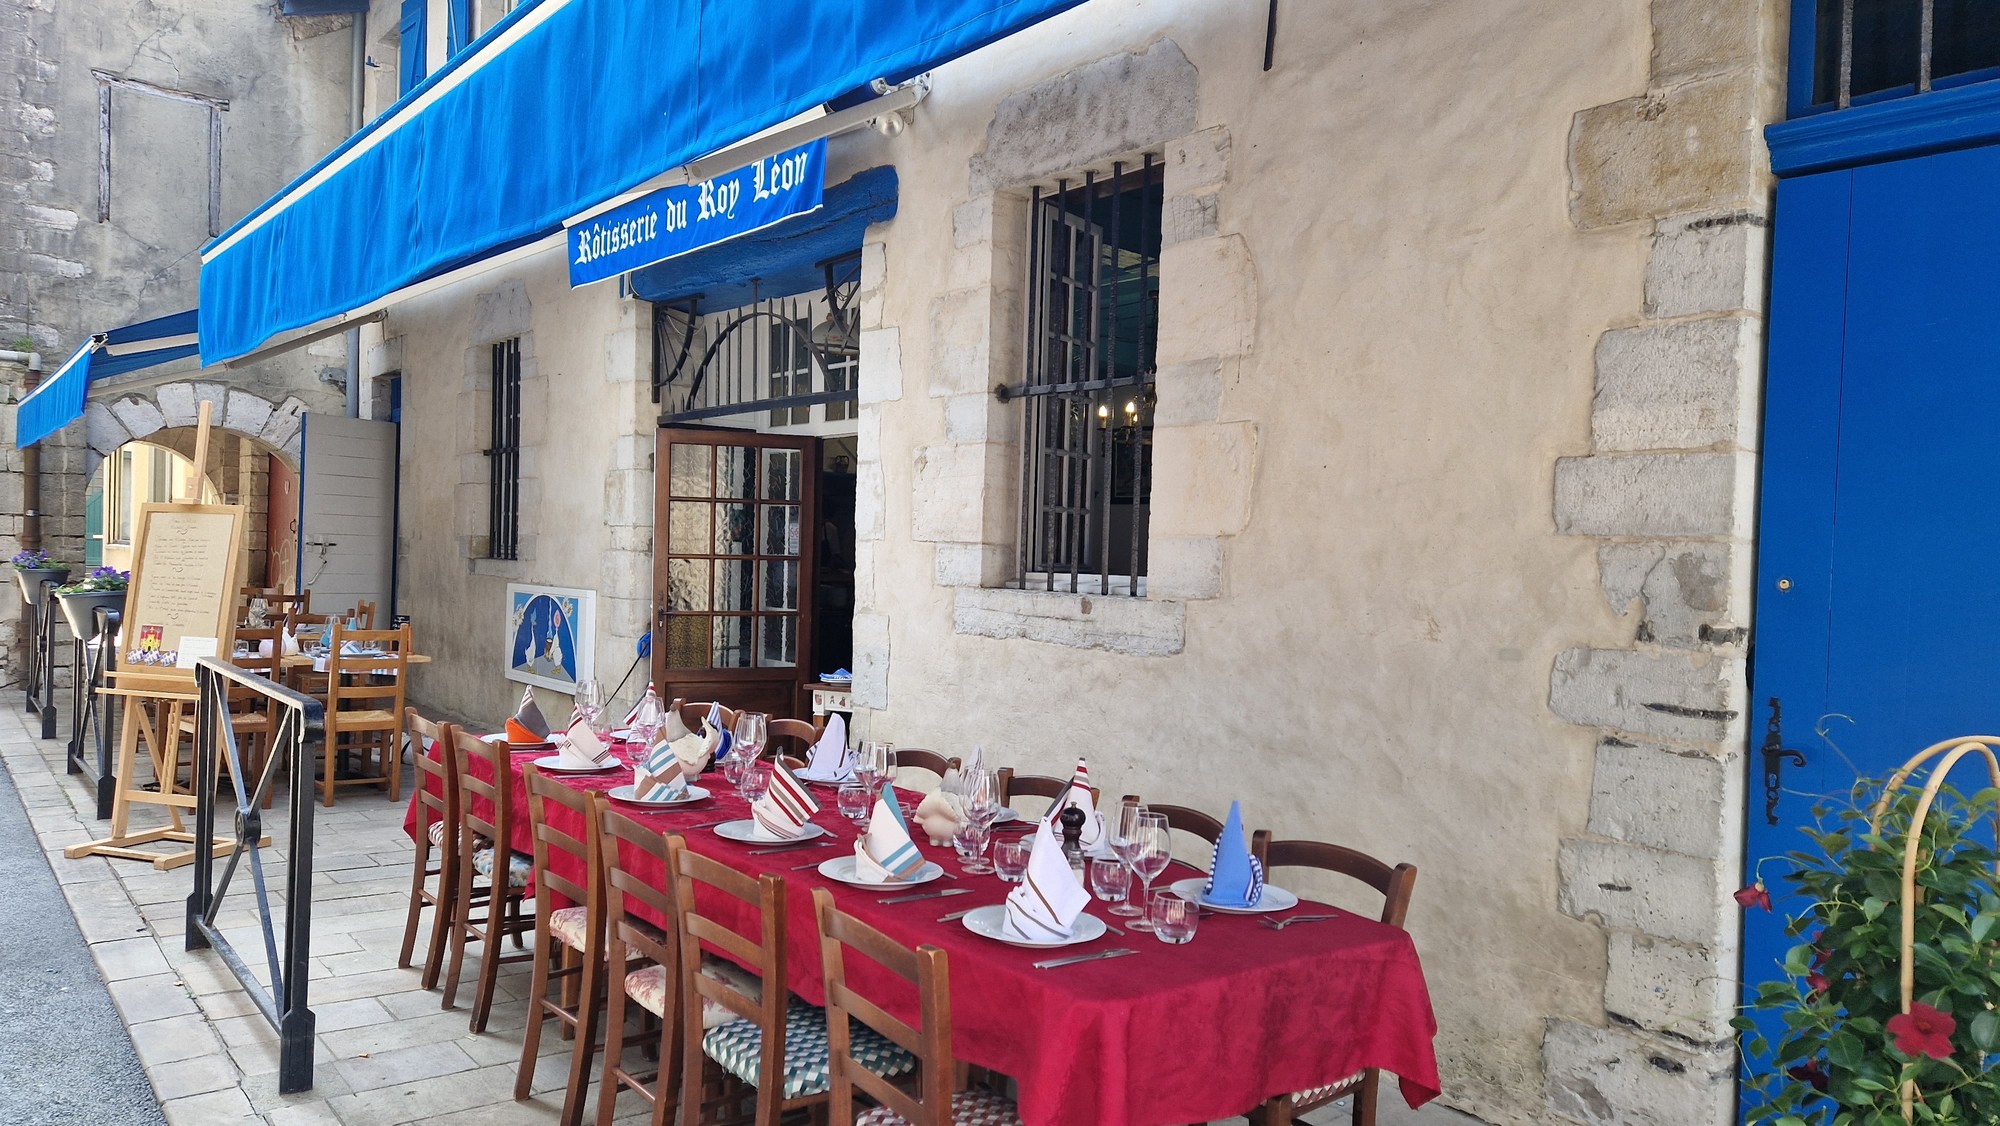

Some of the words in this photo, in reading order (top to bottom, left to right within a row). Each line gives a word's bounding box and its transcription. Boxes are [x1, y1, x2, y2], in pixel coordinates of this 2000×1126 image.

[574, 204, 657, 265] Rôtisserie
[666, 198, 687, 233] du
[697, 177, 740, 222] Roy
[751, 151, 808, 203] Léon
